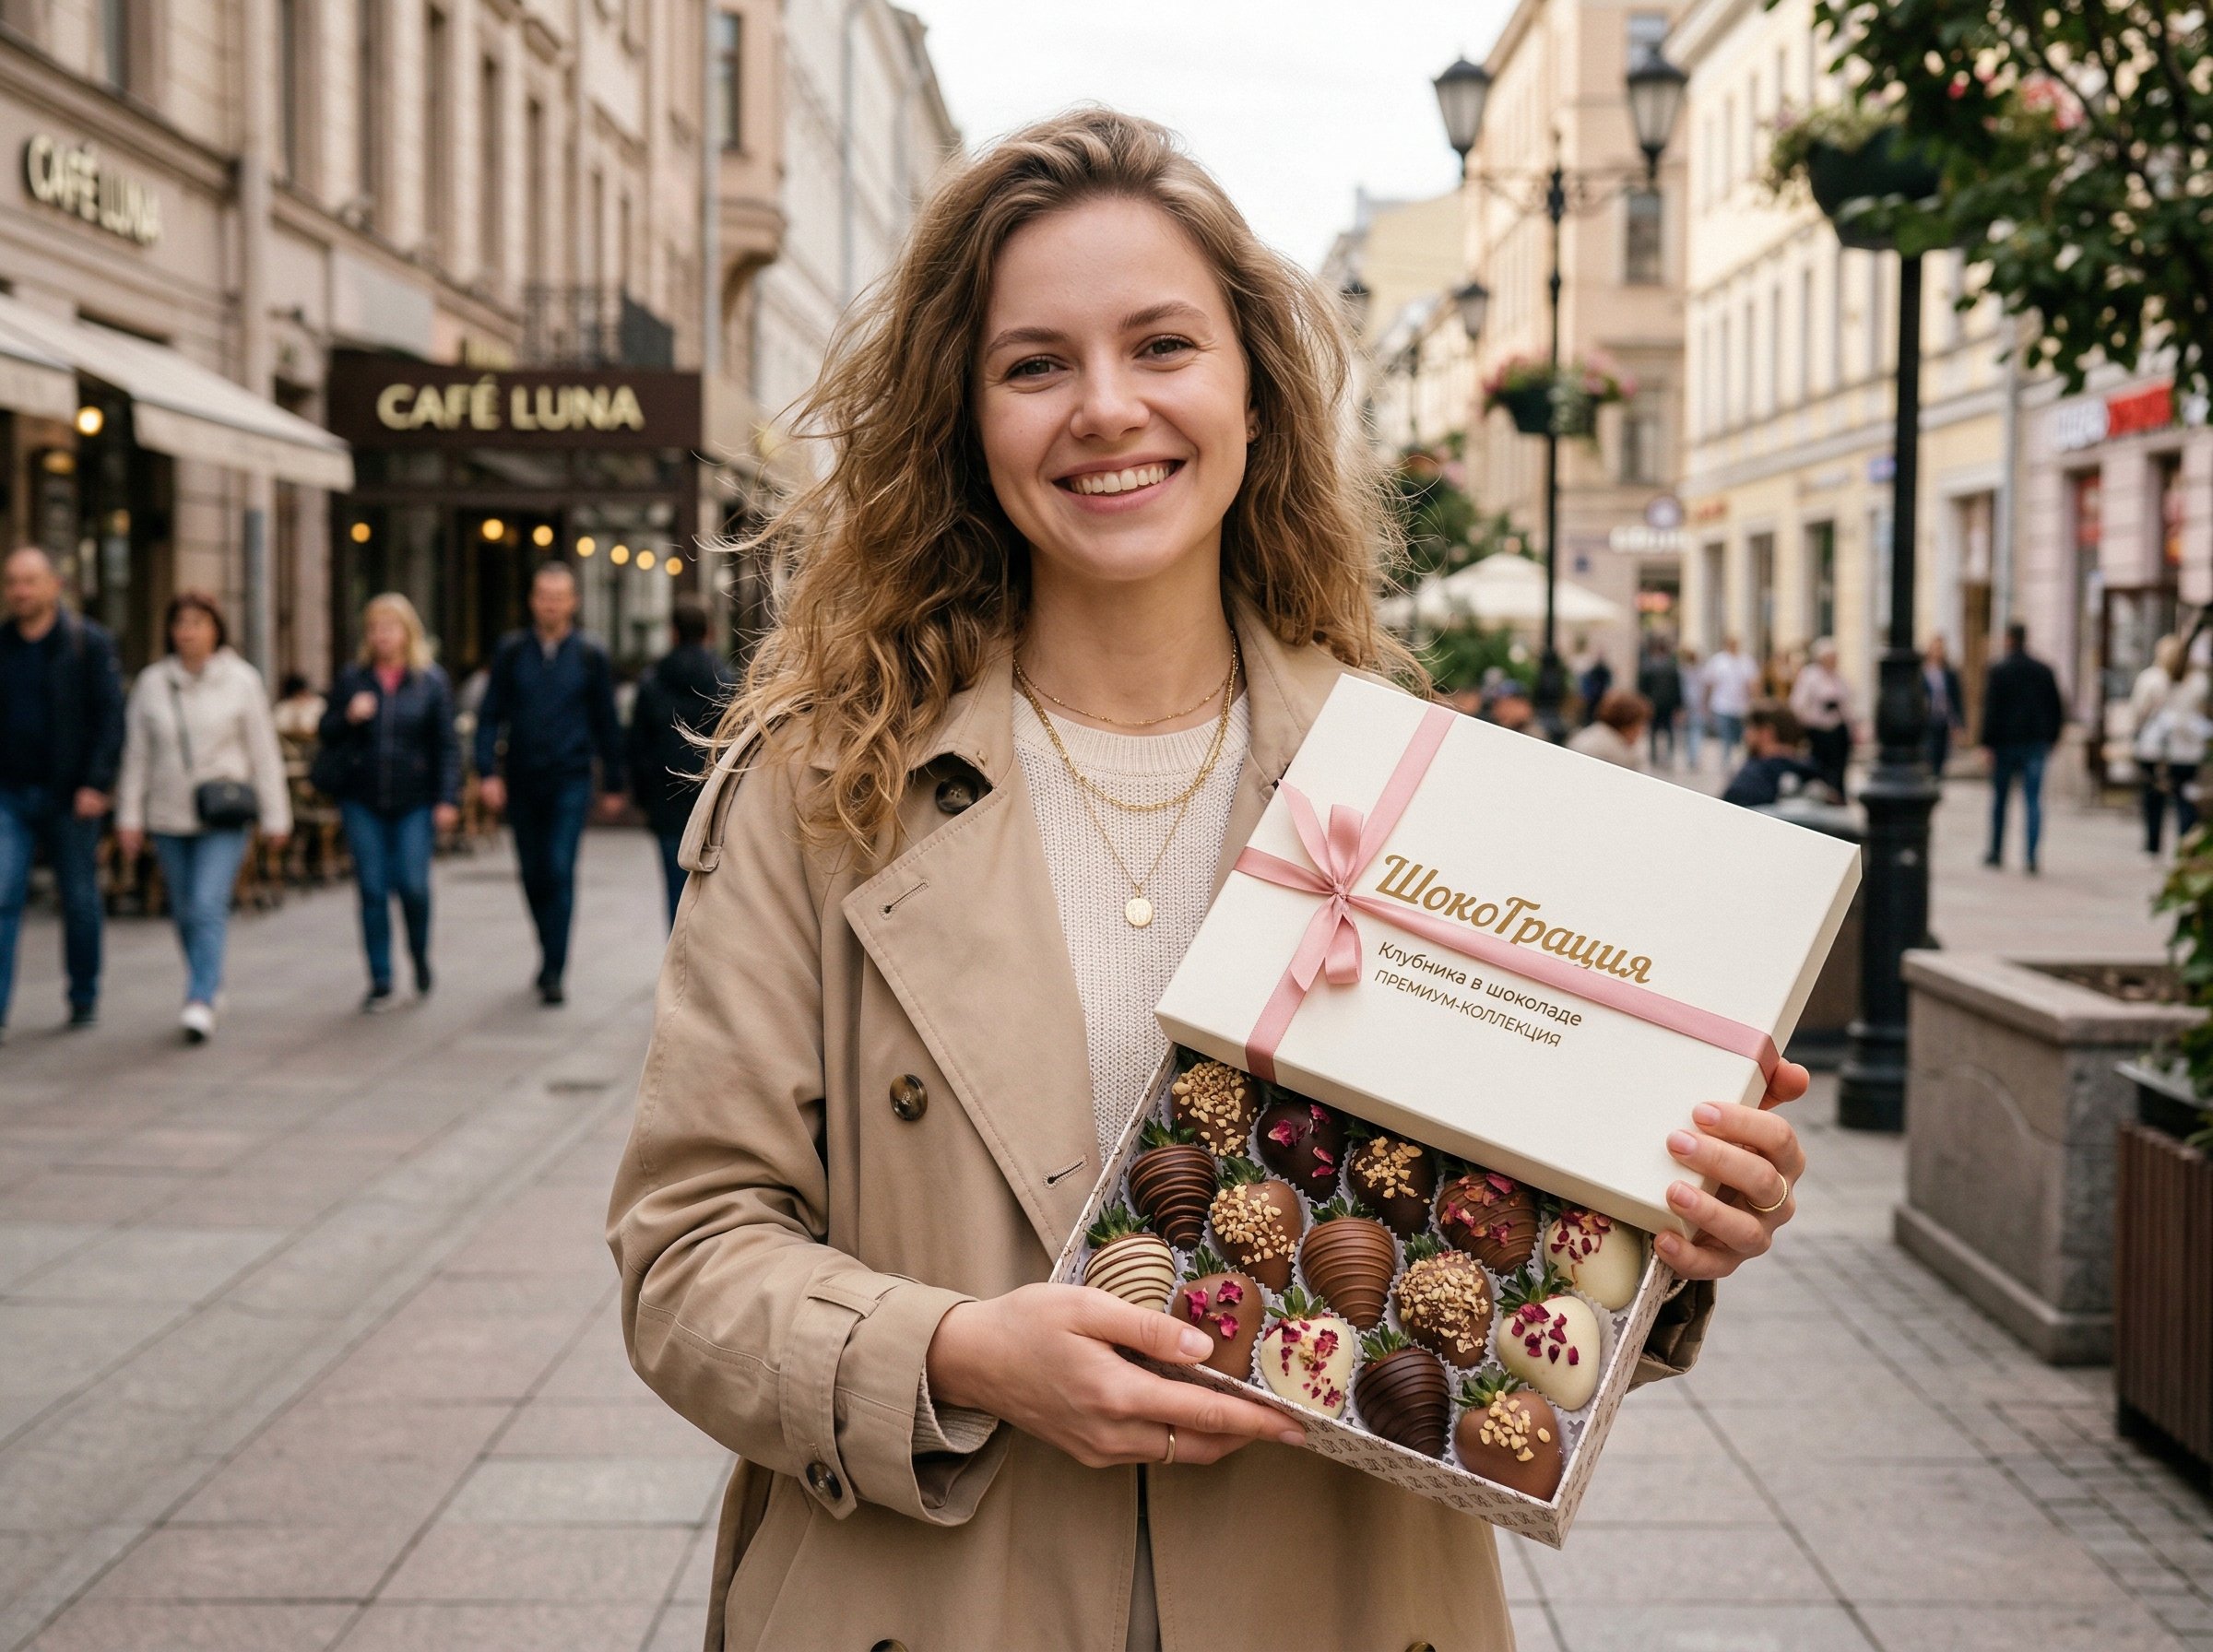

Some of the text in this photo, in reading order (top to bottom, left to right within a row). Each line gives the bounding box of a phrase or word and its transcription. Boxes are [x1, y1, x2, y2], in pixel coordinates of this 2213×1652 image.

[376, 372, 645, 431] CAFÉ LUNA
[1374, 969, 1562, 1047] ПРЕМИУМ-КОЛЛЕКЦИЯ
[1378, 941, 1582, 1026] Клубника в шоколаде
